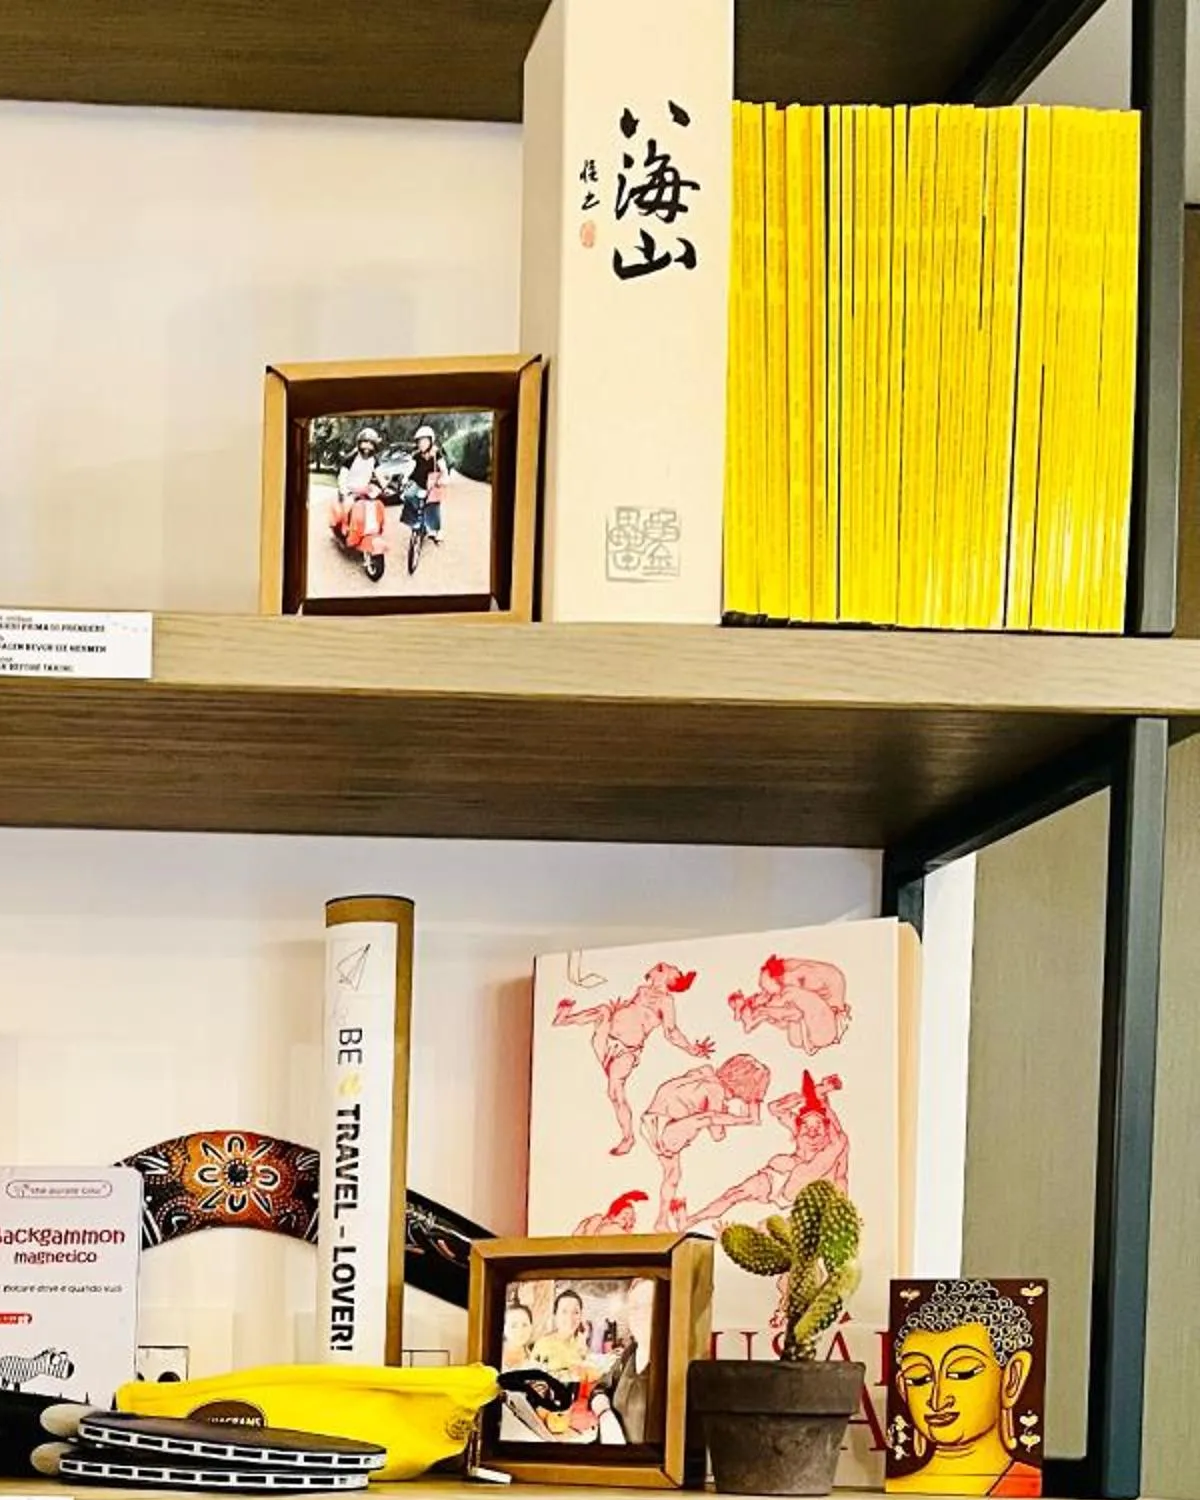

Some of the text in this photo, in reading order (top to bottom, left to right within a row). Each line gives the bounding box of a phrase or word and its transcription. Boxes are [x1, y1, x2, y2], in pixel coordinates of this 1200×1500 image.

[336, 1026, 364, 1066] BE
[333, 1102, 363, 1220] TRAVEL
[13, 1249, 98, 1265] magnetico
[329, 1245, 357, 1353] LOVER!
